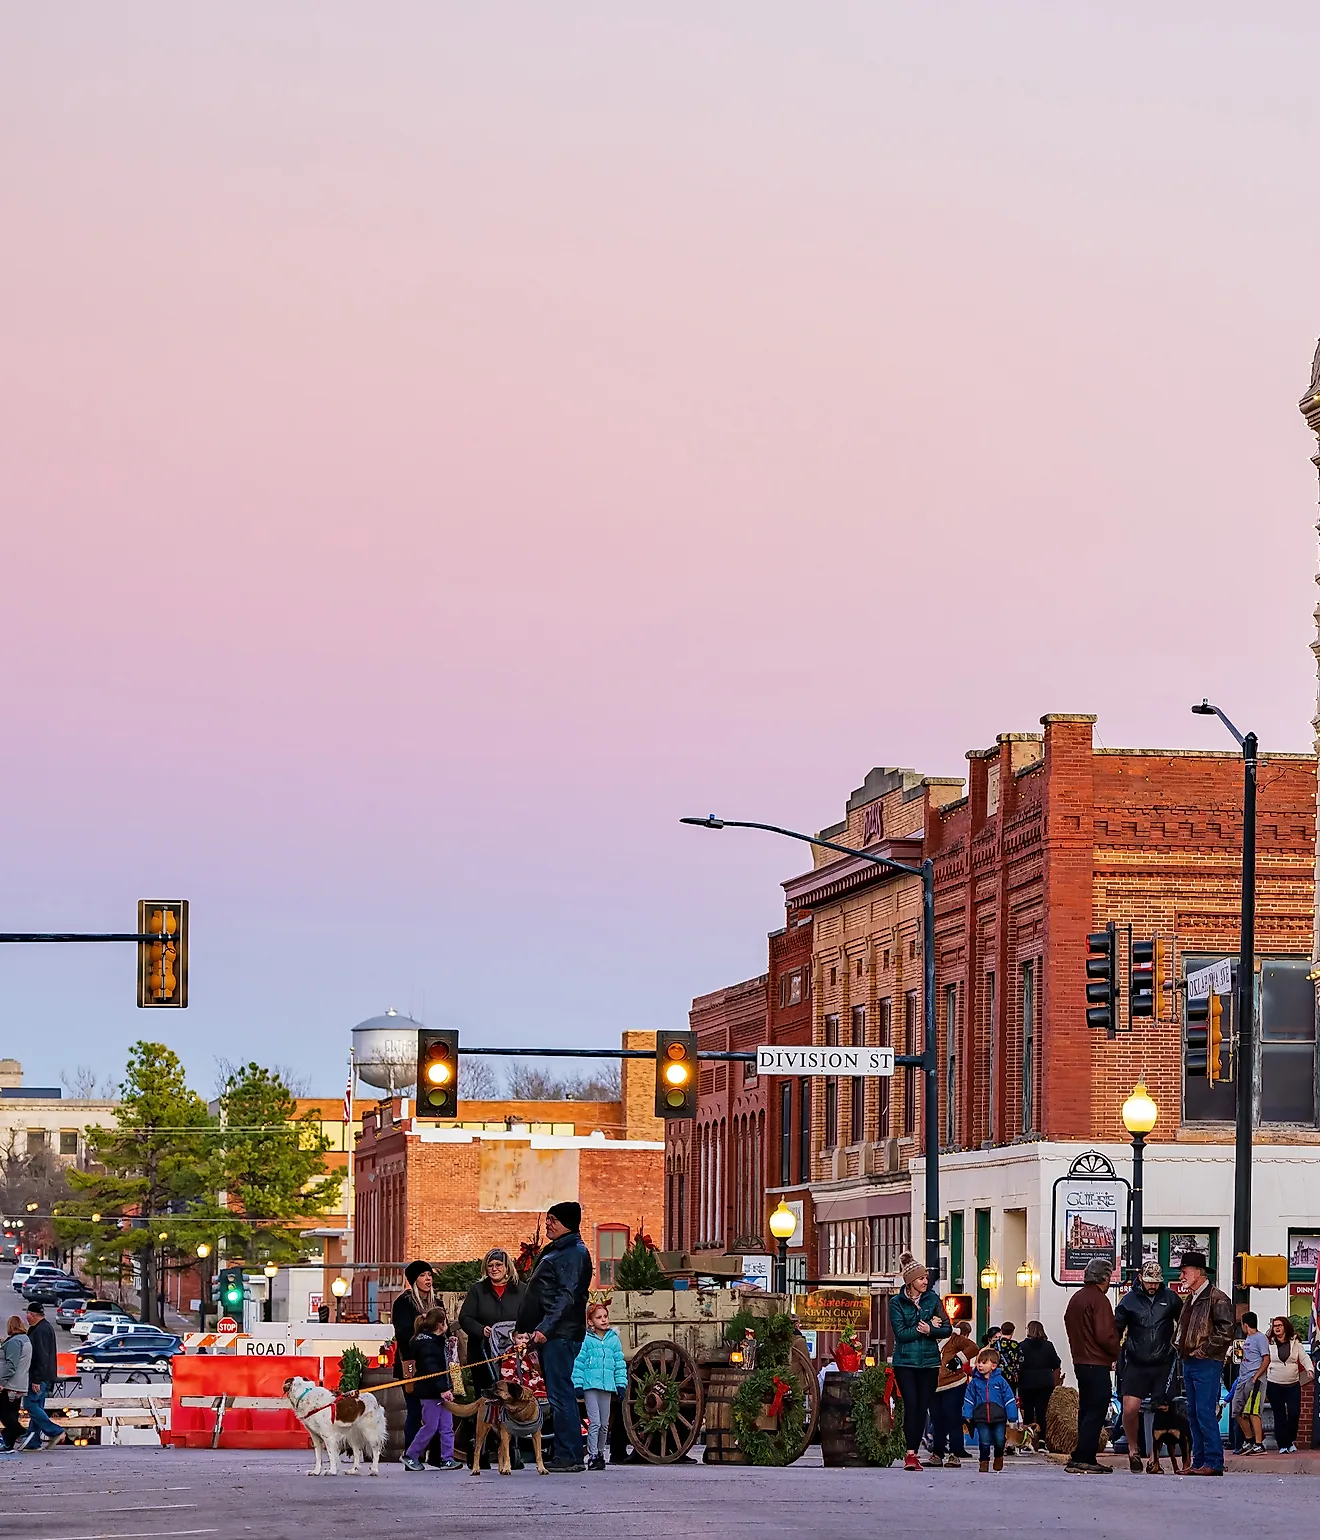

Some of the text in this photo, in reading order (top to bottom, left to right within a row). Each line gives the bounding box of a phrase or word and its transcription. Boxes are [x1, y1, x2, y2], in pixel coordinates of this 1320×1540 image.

[759, 1051, 893, 1069] DIVISION ST
[1066, 1192, 1116, 1208] GUTHRIE
[803, 1308, 862, 1318] KEVIN CRAFT
[218, 1322, 236, 1333] STOP
[246, 1342, 286, 1356] ROAD
